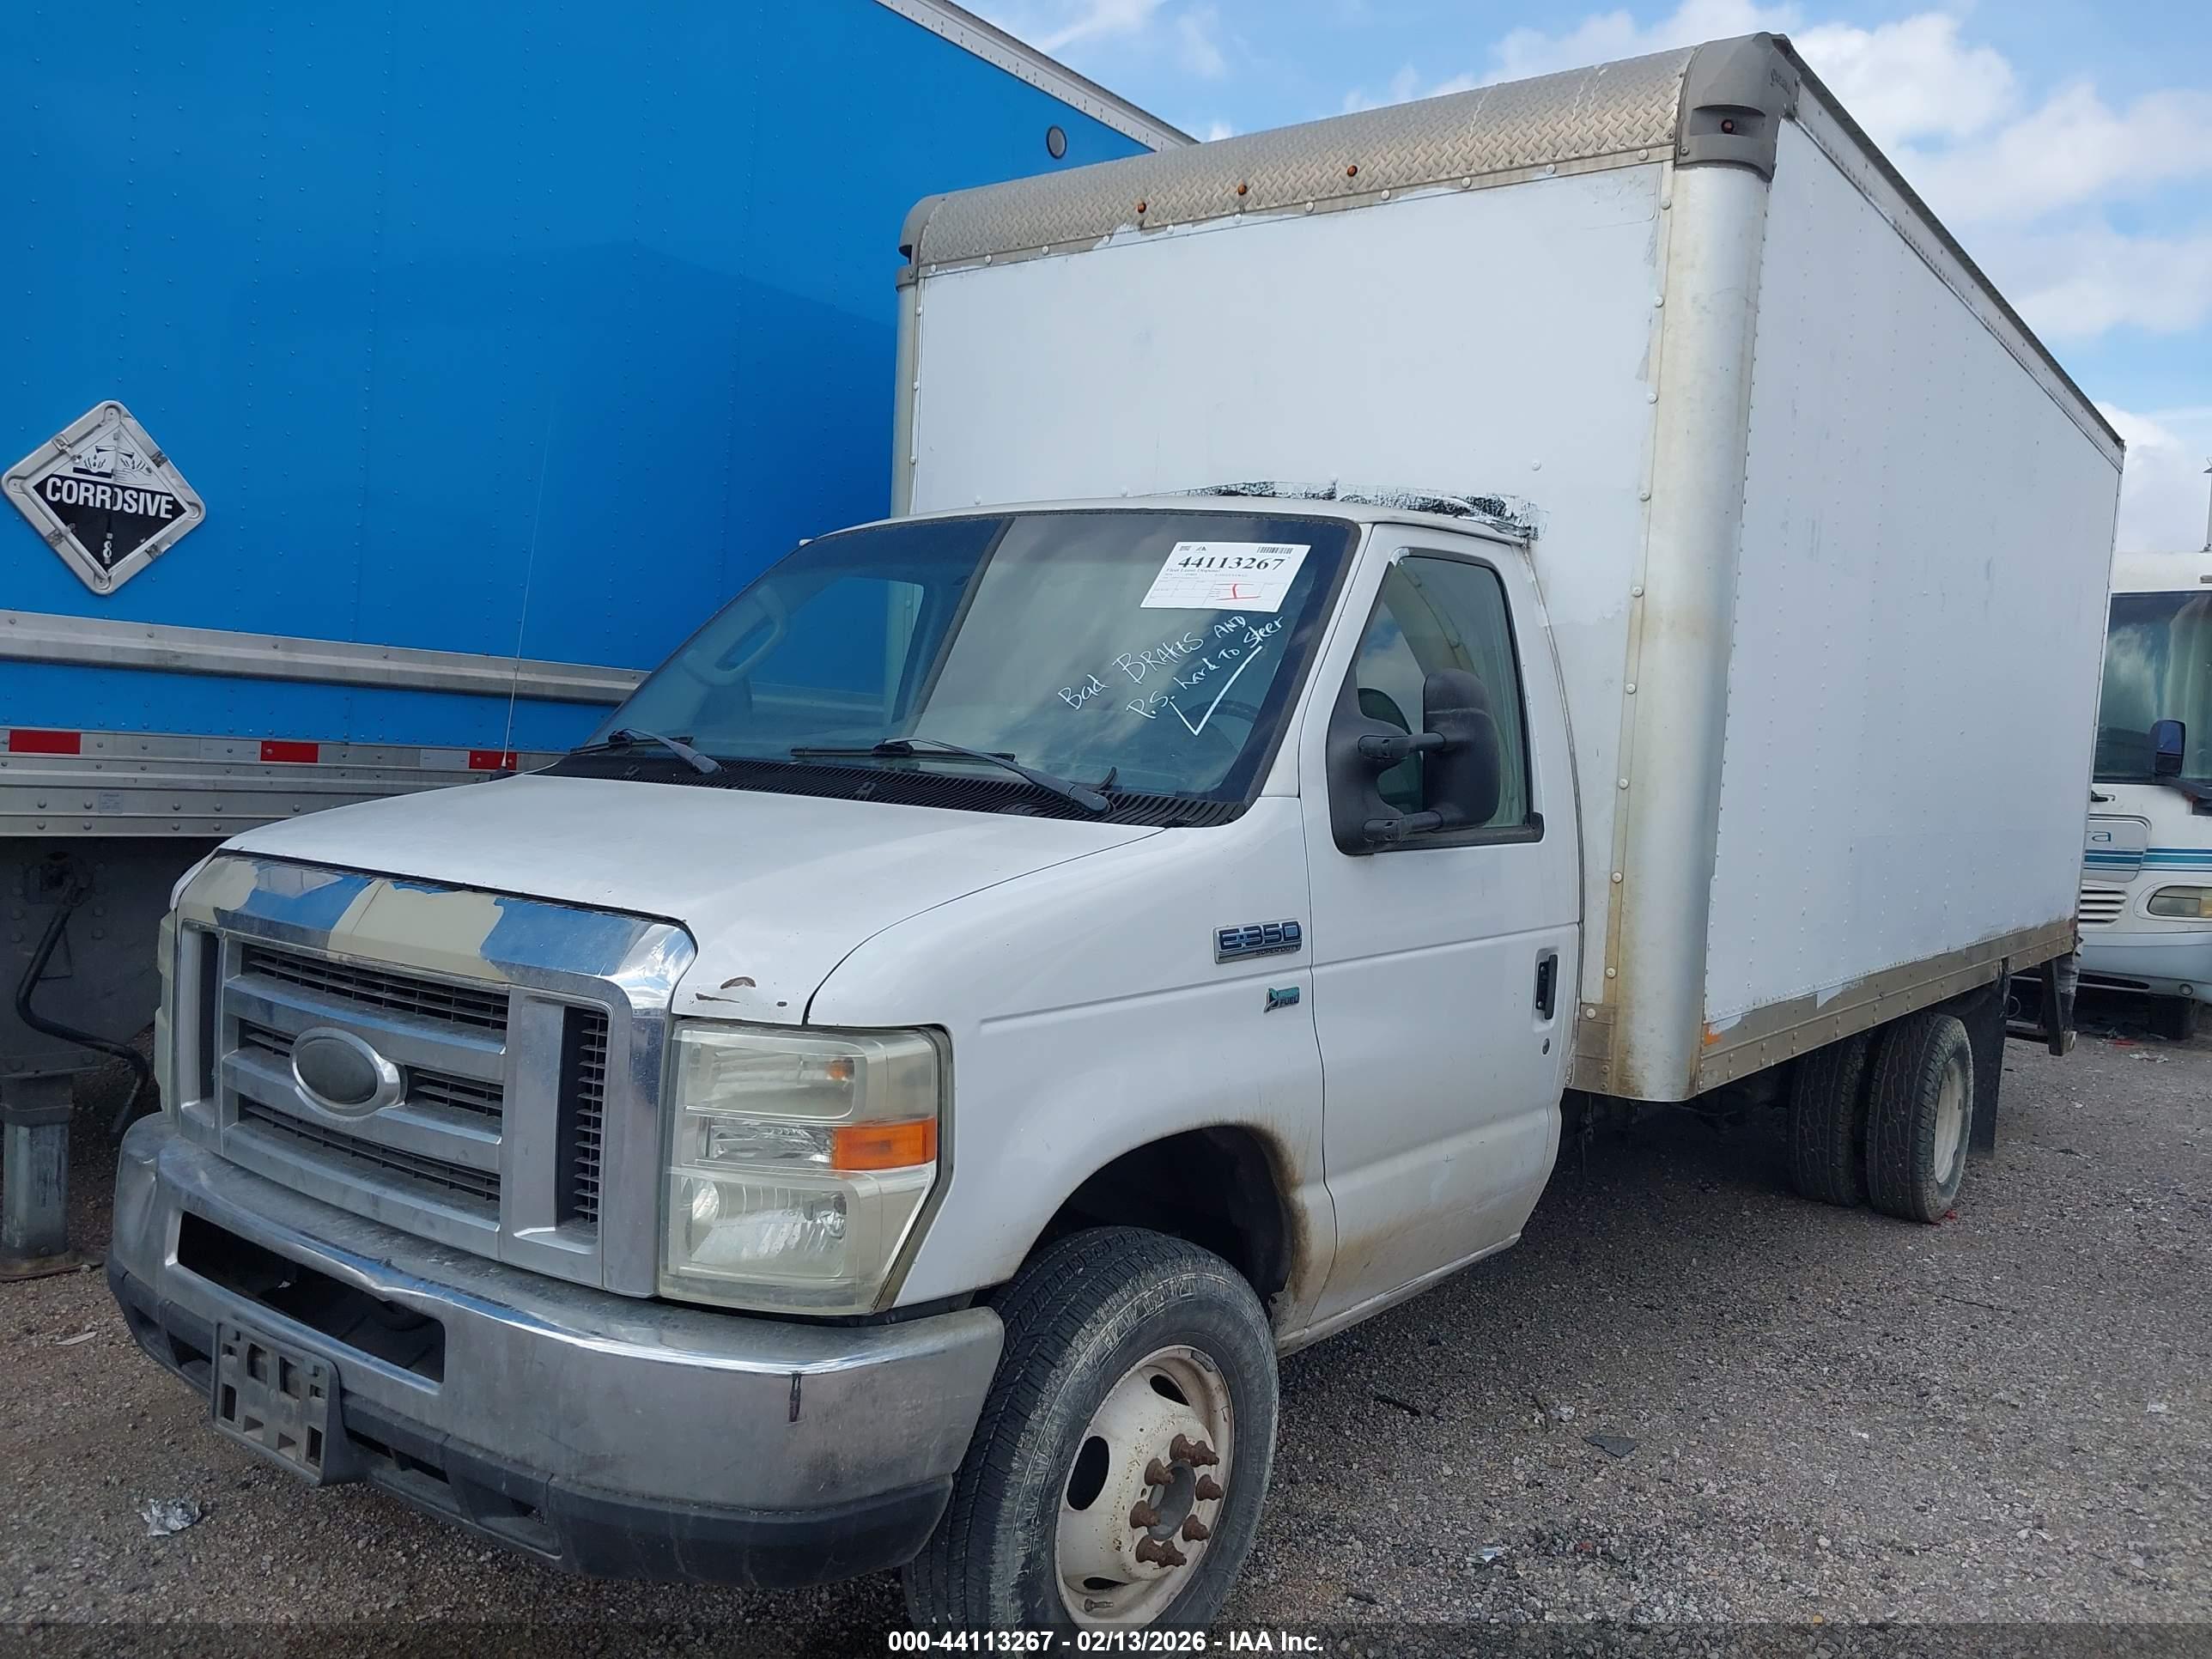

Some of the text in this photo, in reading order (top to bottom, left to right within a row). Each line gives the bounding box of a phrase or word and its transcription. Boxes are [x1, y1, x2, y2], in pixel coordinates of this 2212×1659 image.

[102, 540, 112, 558] 8
[1177, 556, 1286, 571] 44113267
[1058, 674, 1109, 710] Bad
[1214, 616, 1247, 638] AND
[1173, 658, 1220, 690] hard
[1255, 945, 1300, 956] SUPER DUTY
